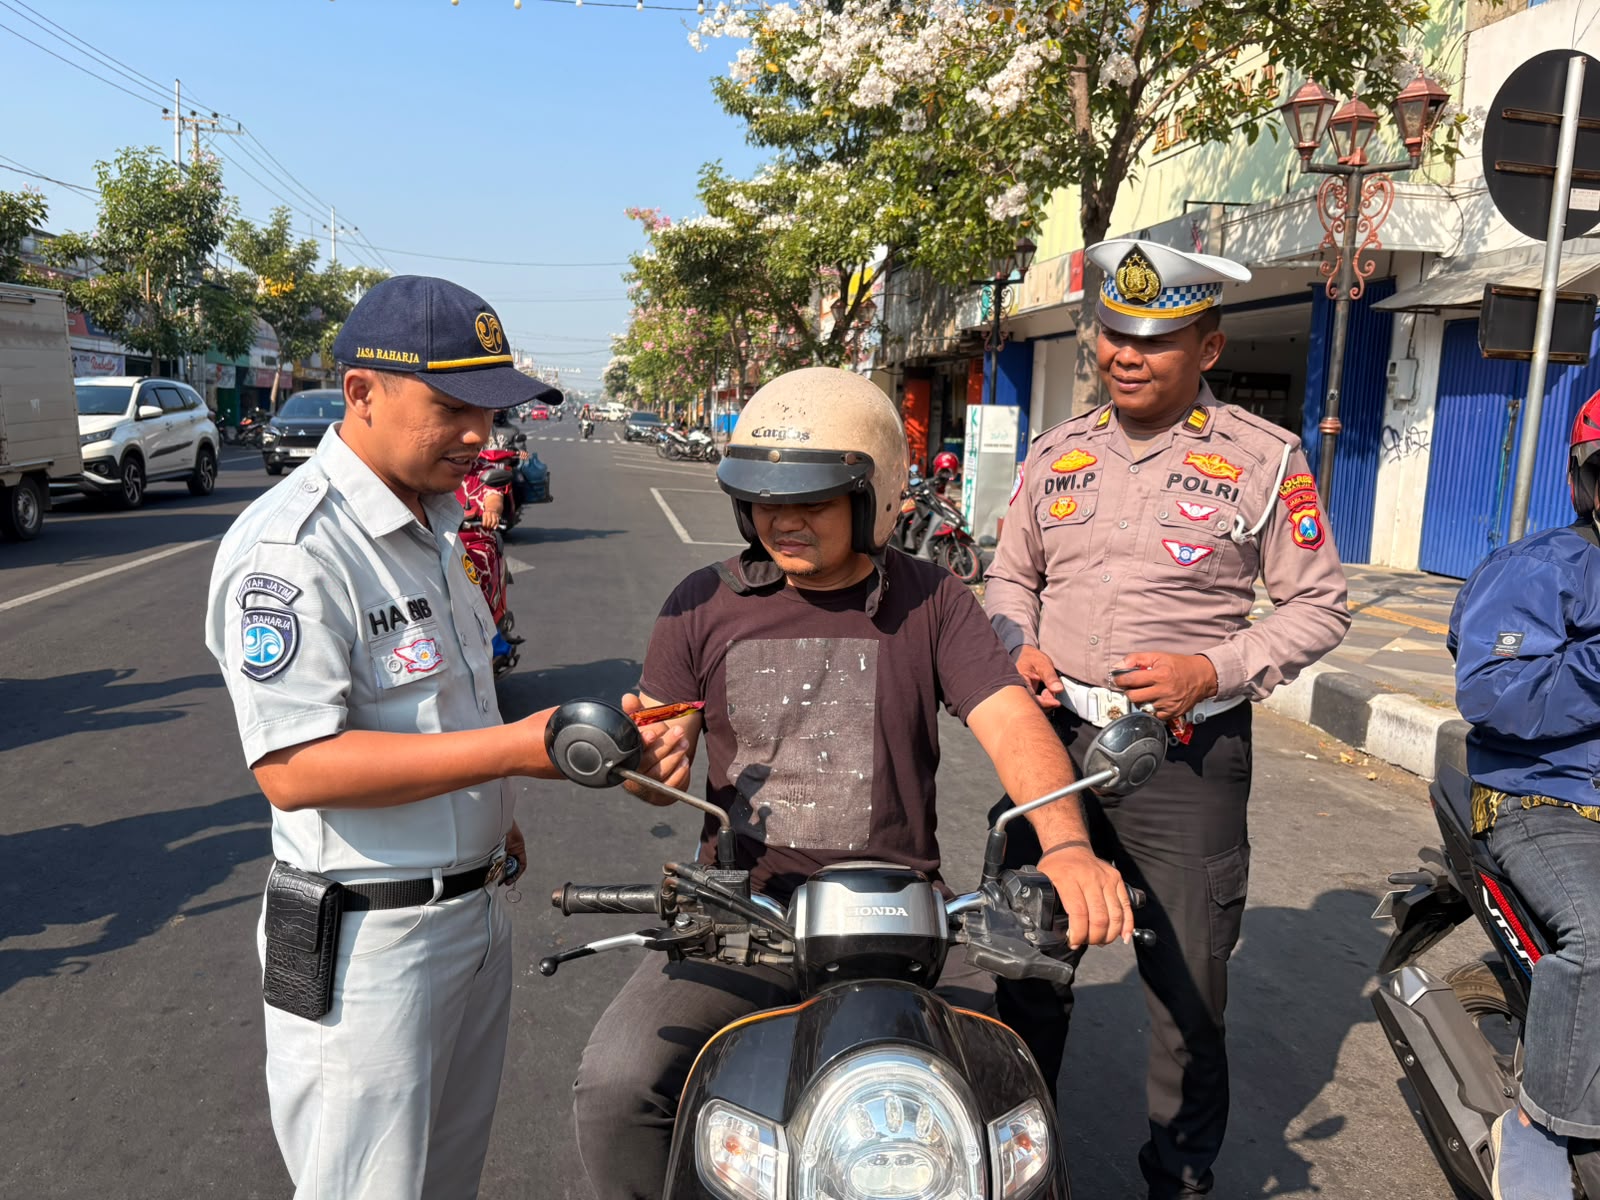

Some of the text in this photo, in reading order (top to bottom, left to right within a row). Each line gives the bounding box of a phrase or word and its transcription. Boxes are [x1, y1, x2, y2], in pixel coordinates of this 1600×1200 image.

[356, 347, 420, 363] JASA RAHARJA
[1045, 472, 1096, 495] DWI.P
[1166, 473, 1240, 502] POLRI
[267, 581, 292, 599] JATIM
[252, 615, 291, 631] RAHARJA
[847, 906, 909, 917] HONDA
